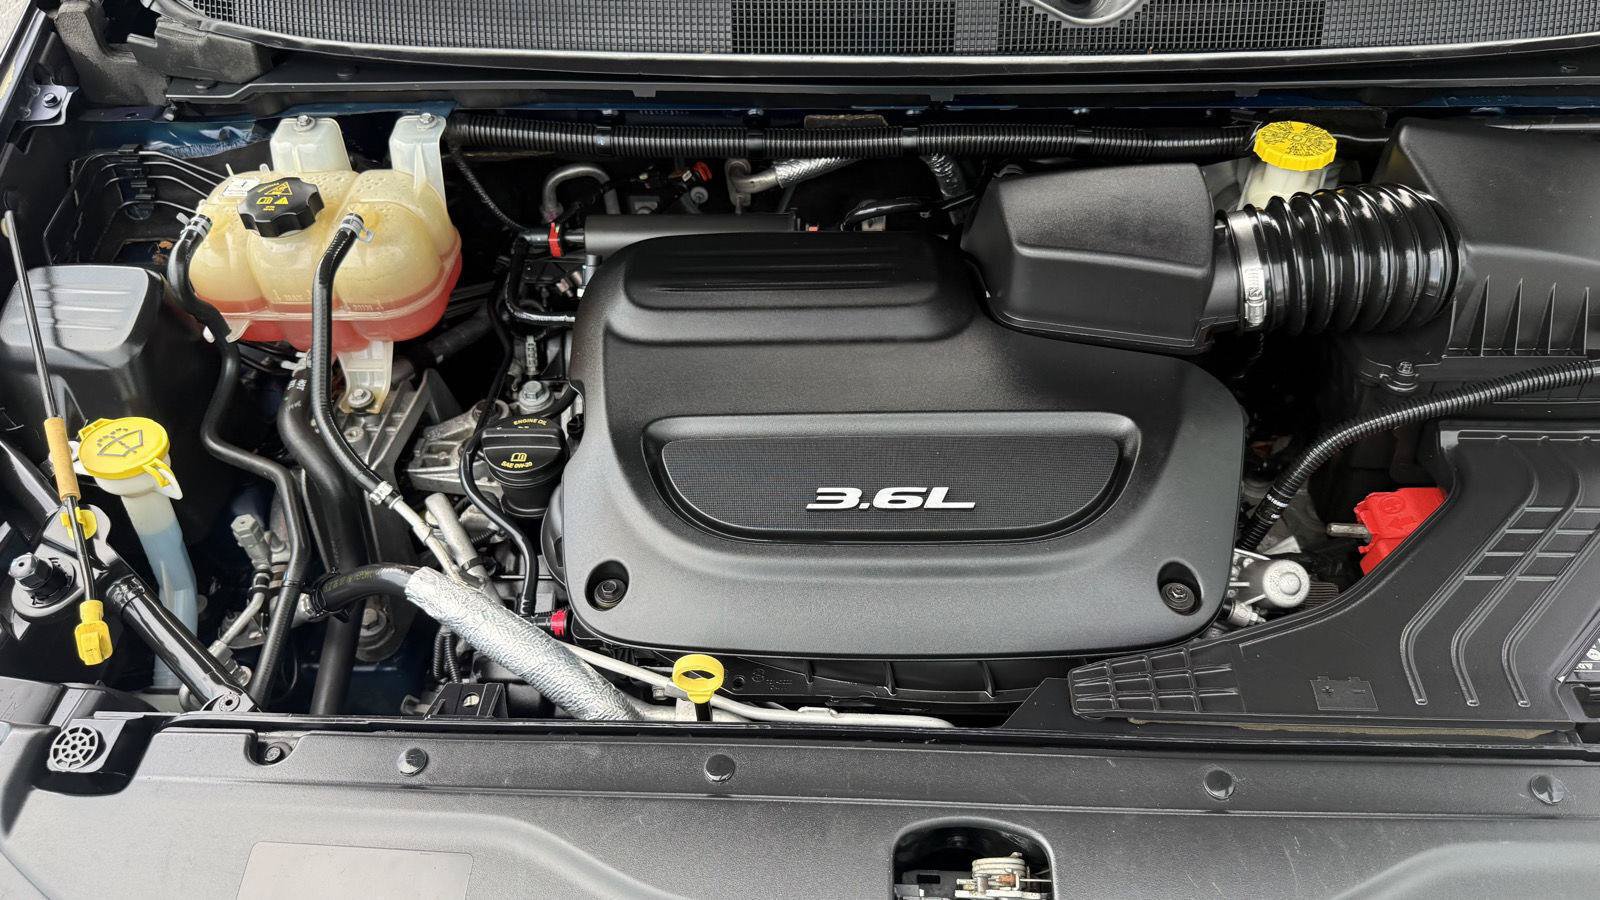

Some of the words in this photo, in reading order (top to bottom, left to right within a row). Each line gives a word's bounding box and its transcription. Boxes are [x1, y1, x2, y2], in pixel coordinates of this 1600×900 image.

[513, 418, 538, 426] ENGINE
[501, 460, 513, 468] SAE
[805, 486, 976, 510] 3.6L
